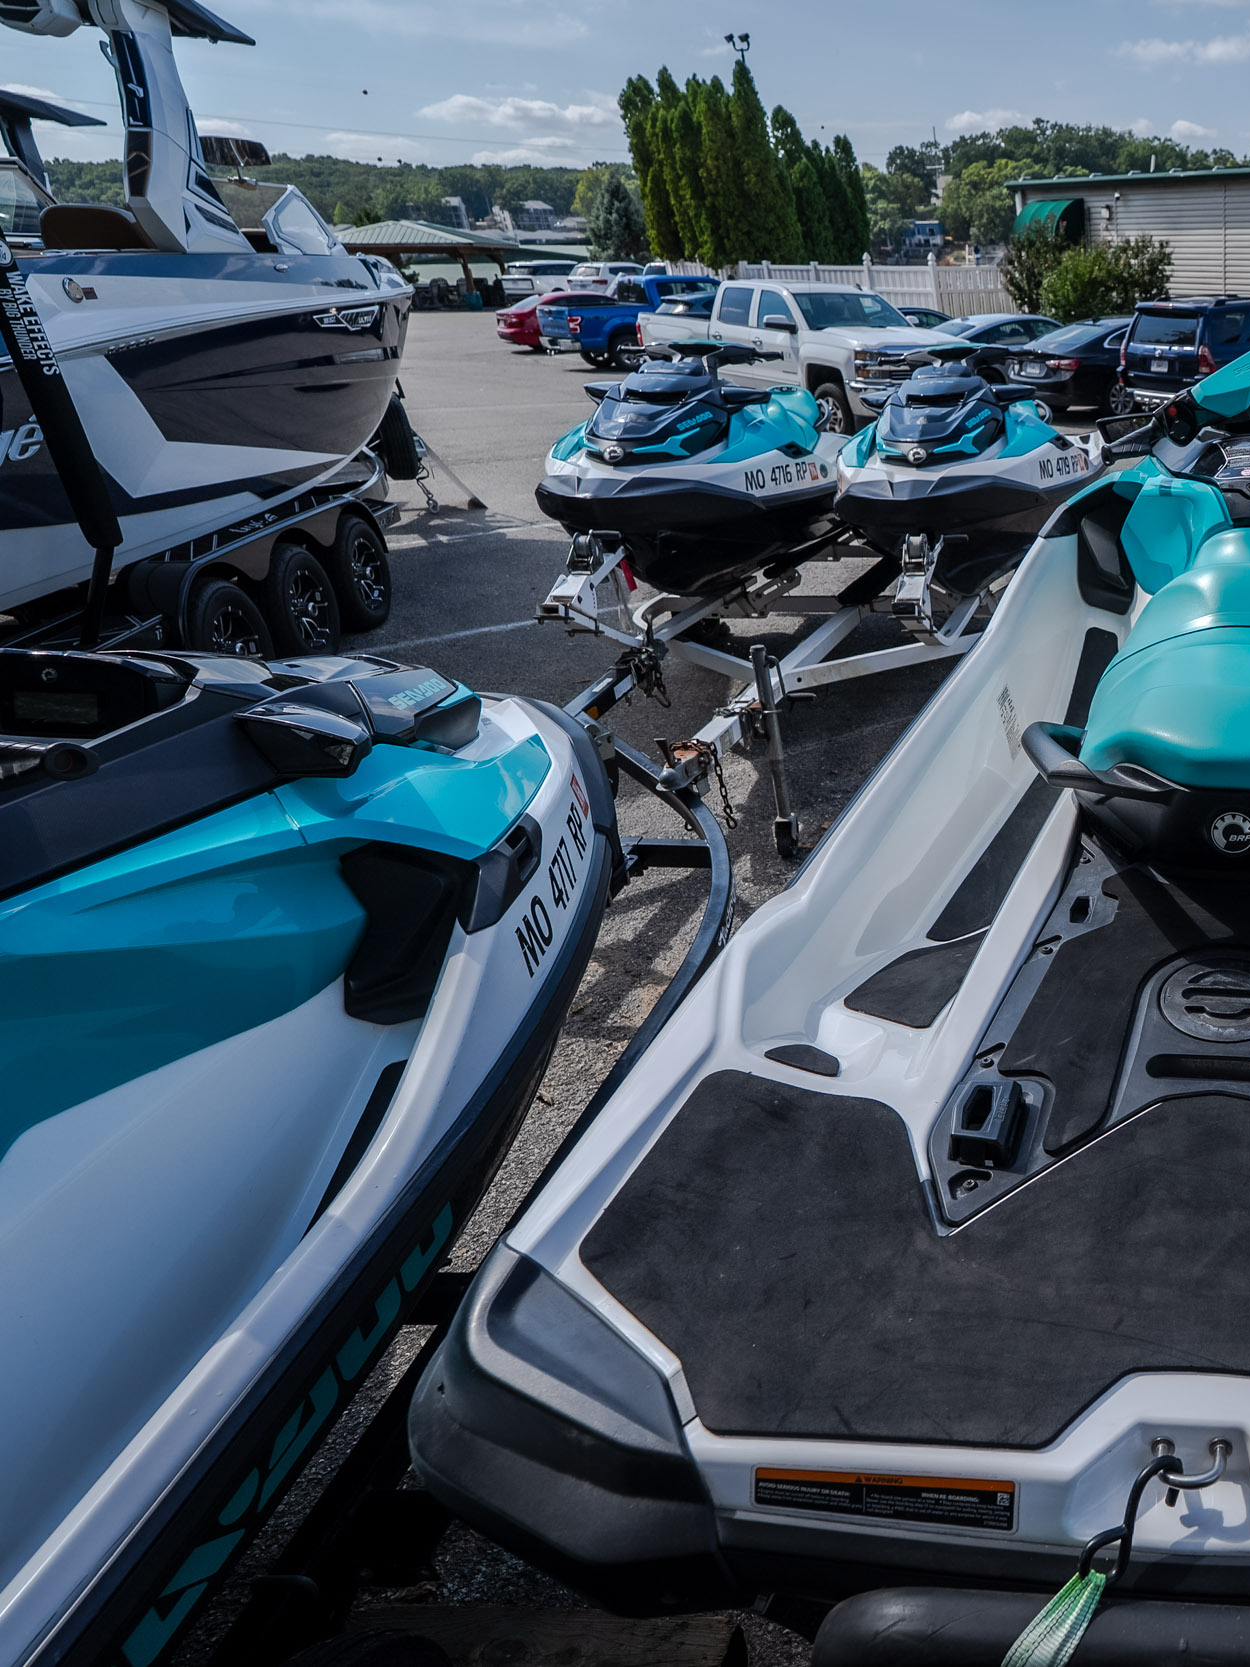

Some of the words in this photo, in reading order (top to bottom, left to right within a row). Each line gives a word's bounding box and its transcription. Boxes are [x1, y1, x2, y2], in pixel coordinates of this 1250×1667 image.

[0, 287, 13, 302] BY
[4, 301, 21, 319] BIG
[6, 271, 37, 314] WAKE
[23, 315, 59, 376] EFFECTS
[9, 318, 37, 361] THUNDER
[744, 468, 766, 492] MO
[770, 464, 793, 486] 4716
[795, 461, 808, 482] RP
[1039, 458, 1054, 480] MO
[1056, 455, 1070, 476] 4719
[514, 895, 553, 979] MO
[548, 835, 577, 911] 4717
[566, 801, 587, 861] RP
[777, 1483, 800, 1492] SERIOUS
[865, 1476, 904, 1485] WARNING
